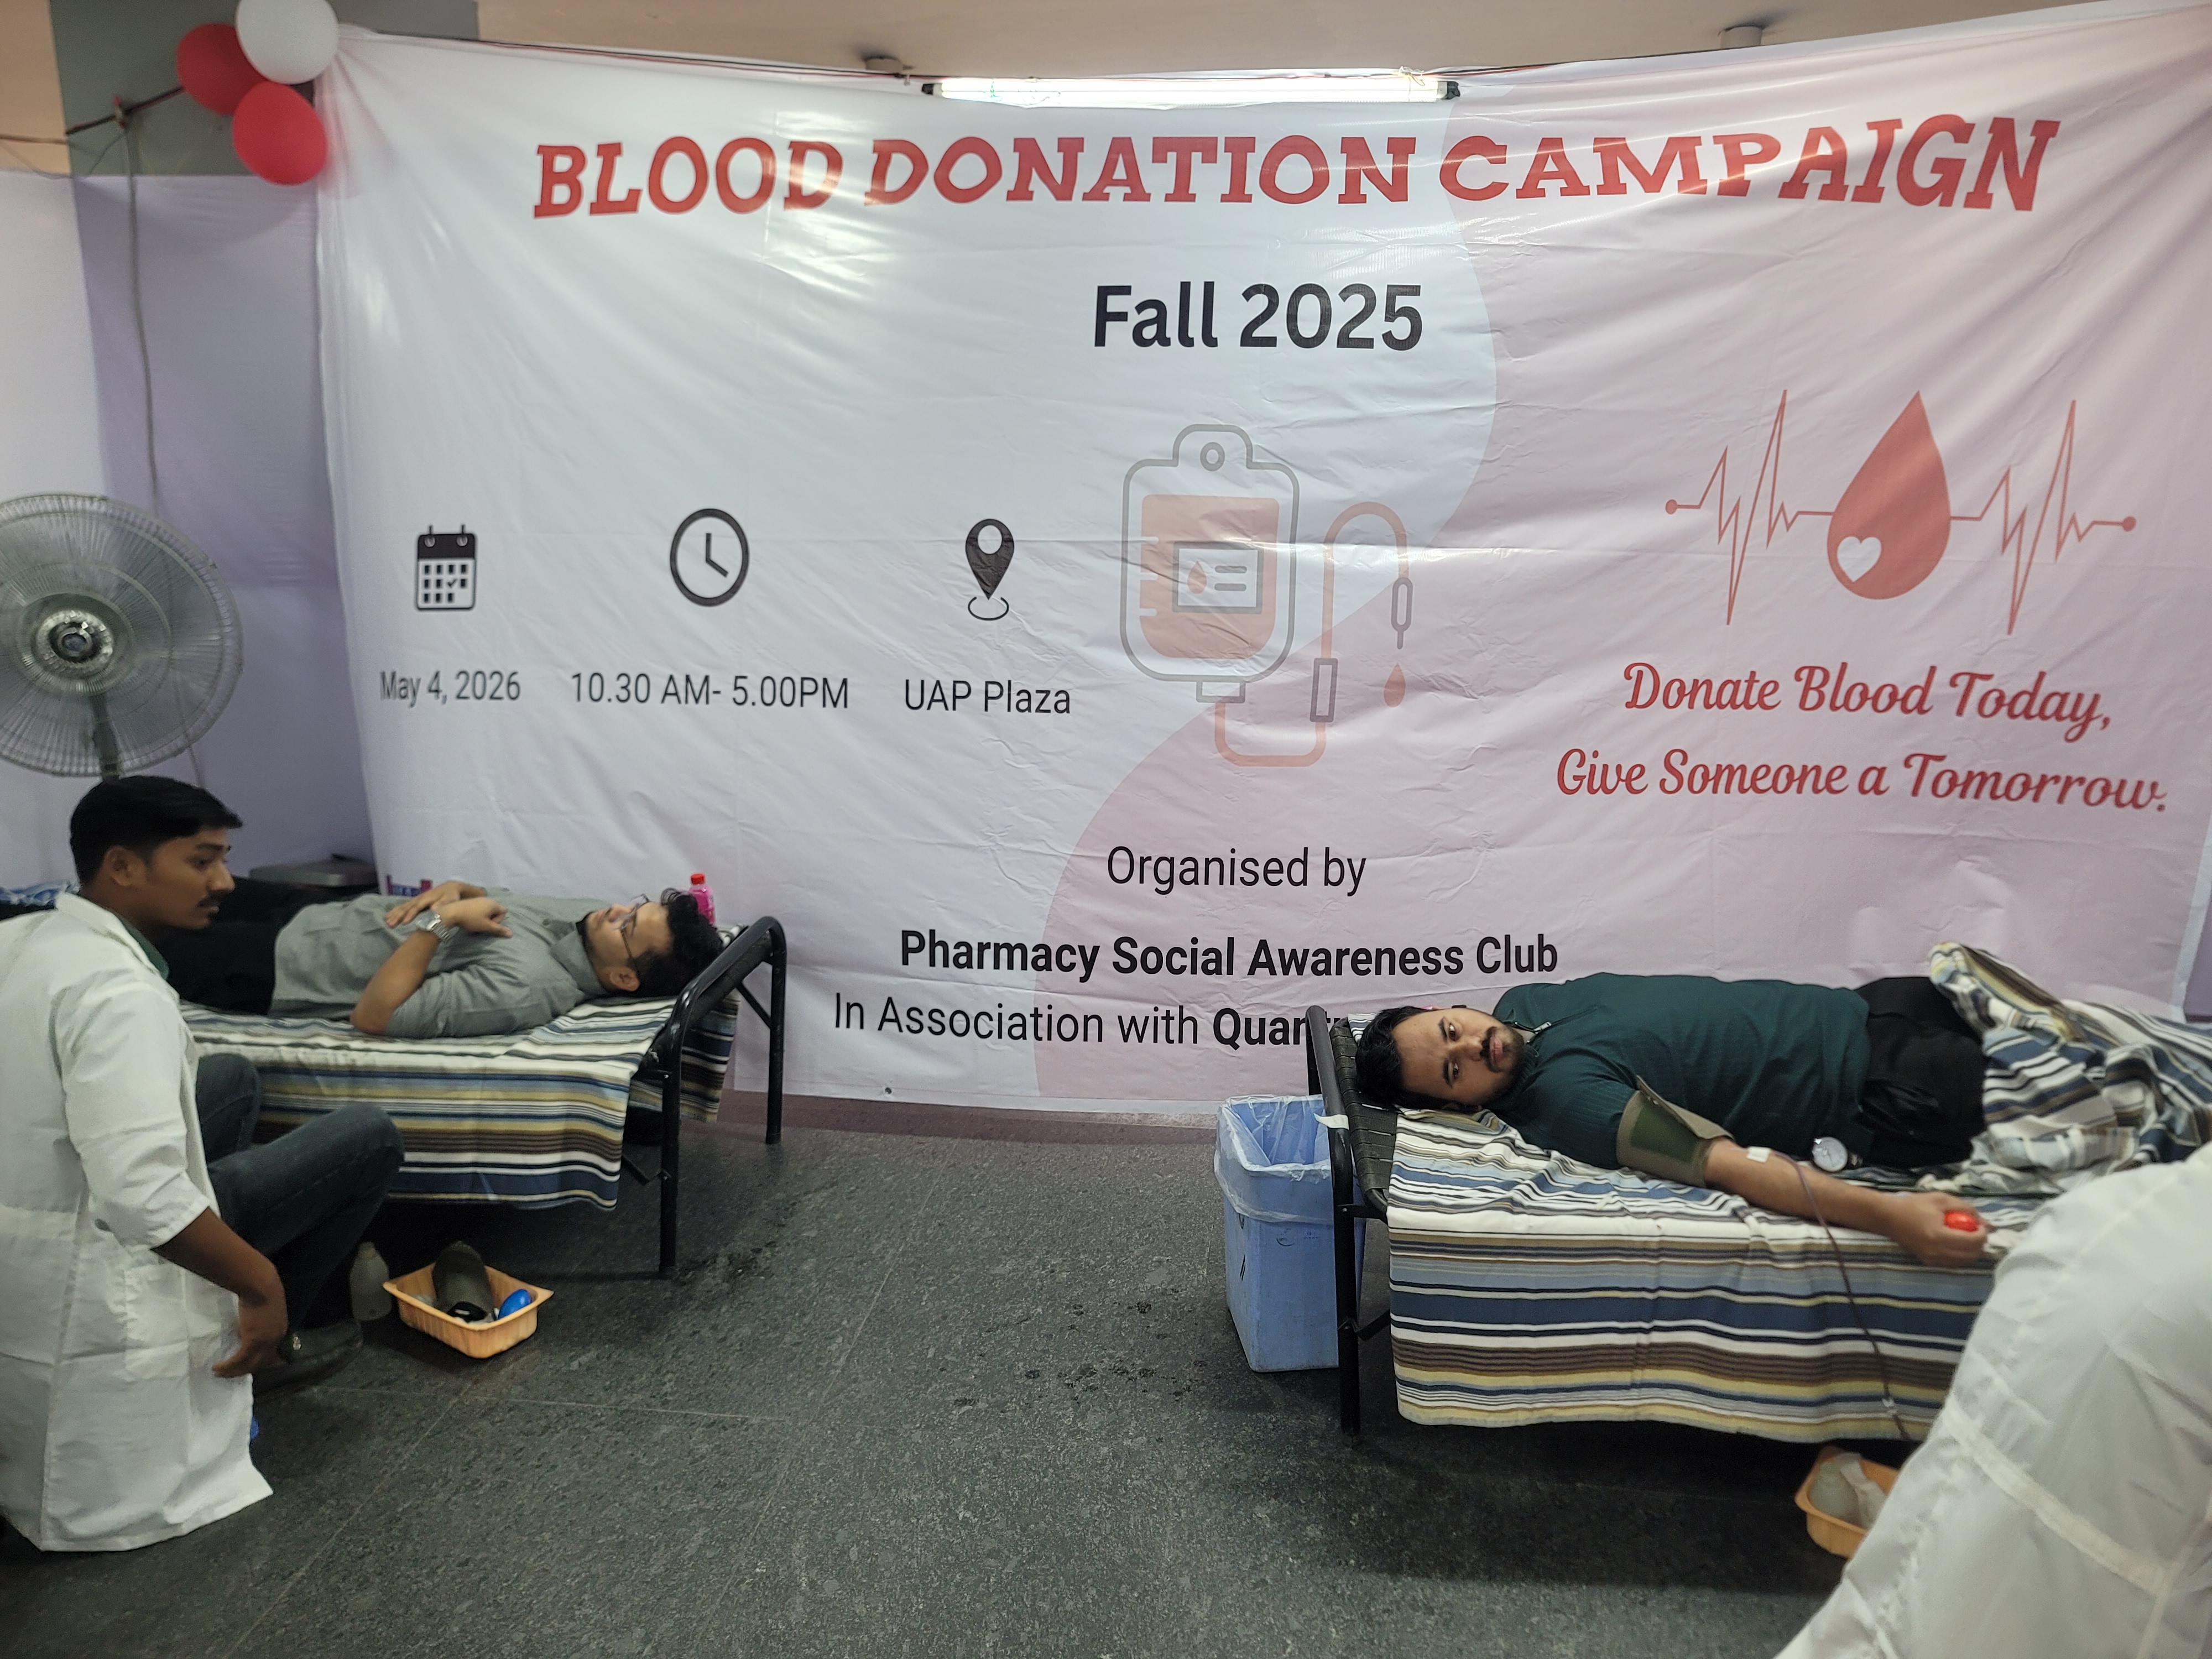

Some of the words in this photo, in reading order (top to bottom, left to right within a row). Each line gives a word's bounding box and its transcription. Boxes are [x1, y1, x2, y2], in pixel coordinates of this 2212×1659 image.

[533, 137, 844, 218] BLOOD
[864, 136, 1416, 206] DONATION
[1439, 113, 2059, 212] CAMPAIGN
[1094, 280, 1218, 348] Fall
[1239, 283, 1422, 351] 2025
[380, 670, 421, 707] May
[427, 670, 447, 705] 4,
[455, 670, 521, 701] 2026
[571, 672, 651, 704] 10.30
[660, 674, 722, 705] AM-
[732, 675, 848, 709] 5.00PM
[905, 679, 972, 712] UAP
[984, 679, 1071, 714] Plaza
[1624, 662, 1781, 711] Donate
[1794, 662, 1937, 714] Blood
[1949, 671, 2111, 742] Today,
[1557, 749, 1648, 795] Give
[1659, 749, 1848, 795] Someone
[1858, 766, 1889, 795] a
[1904, 753, 2167, 812] Tomorrow.
[1108, 846, 1308, 896] Organised
[1324, 847, 1367, 897] by
[901, 929, 1100, 984] Pharmacy
[1112, 936, 1235, 977] Social
[1246, 938, 1464, 977] Awareness
[1476, 933, 1558, 974] Club
[835, 992, 864, 1030] In
[877, 996, 1103, 1043] Association
[1117, 1004, 1198, 1045] with
